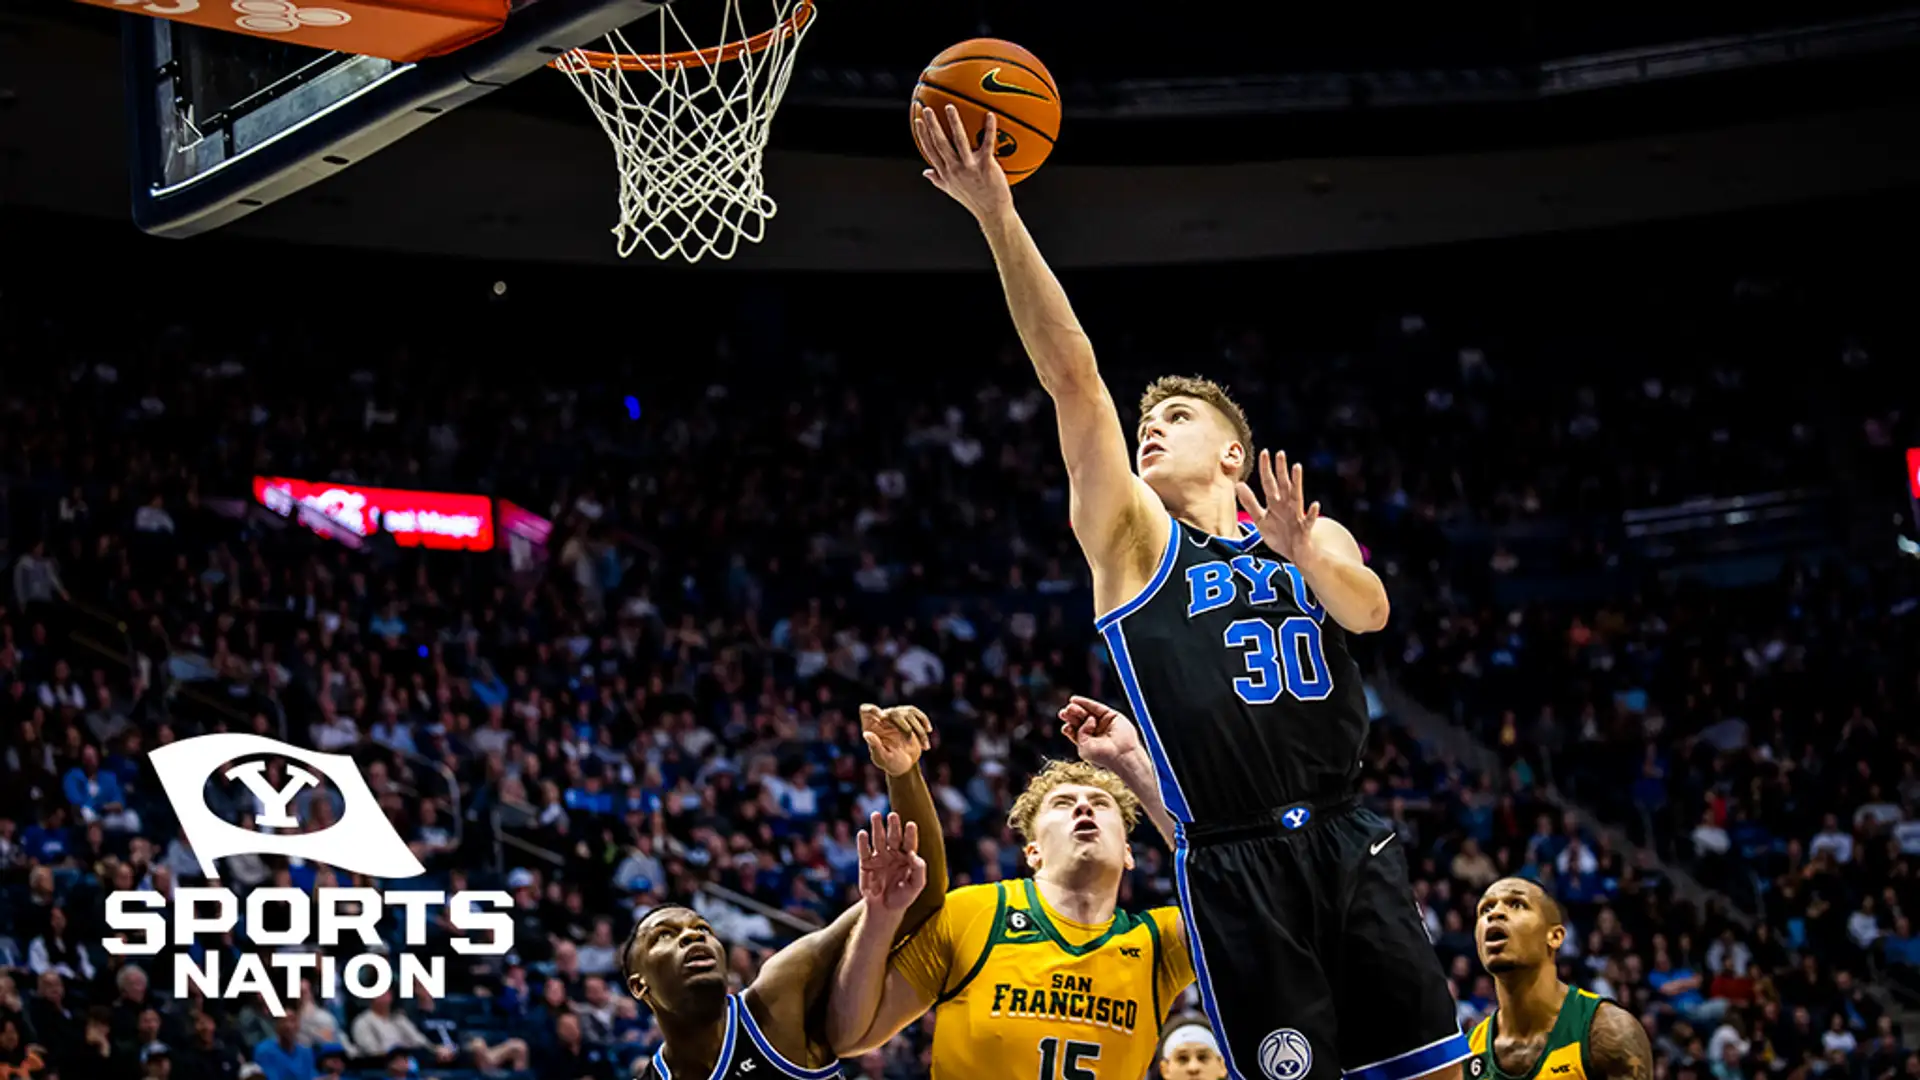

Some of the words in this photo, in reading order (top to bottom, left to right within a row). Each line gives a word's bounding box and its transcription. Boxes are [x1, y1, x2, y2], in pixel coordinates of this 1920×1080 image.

[1224, 617, 1334, 704] 30
[1285, 808, 1307, 828] Y
[1011, 912, 1026, 928] 6
[1052, 974, 1092, 993] SAN
[991, 984, 1137, 1033] FRANCISCO
[1038, 1037, 1102, 1080] 15
[1470, 1058, 1482, 1076] 6
